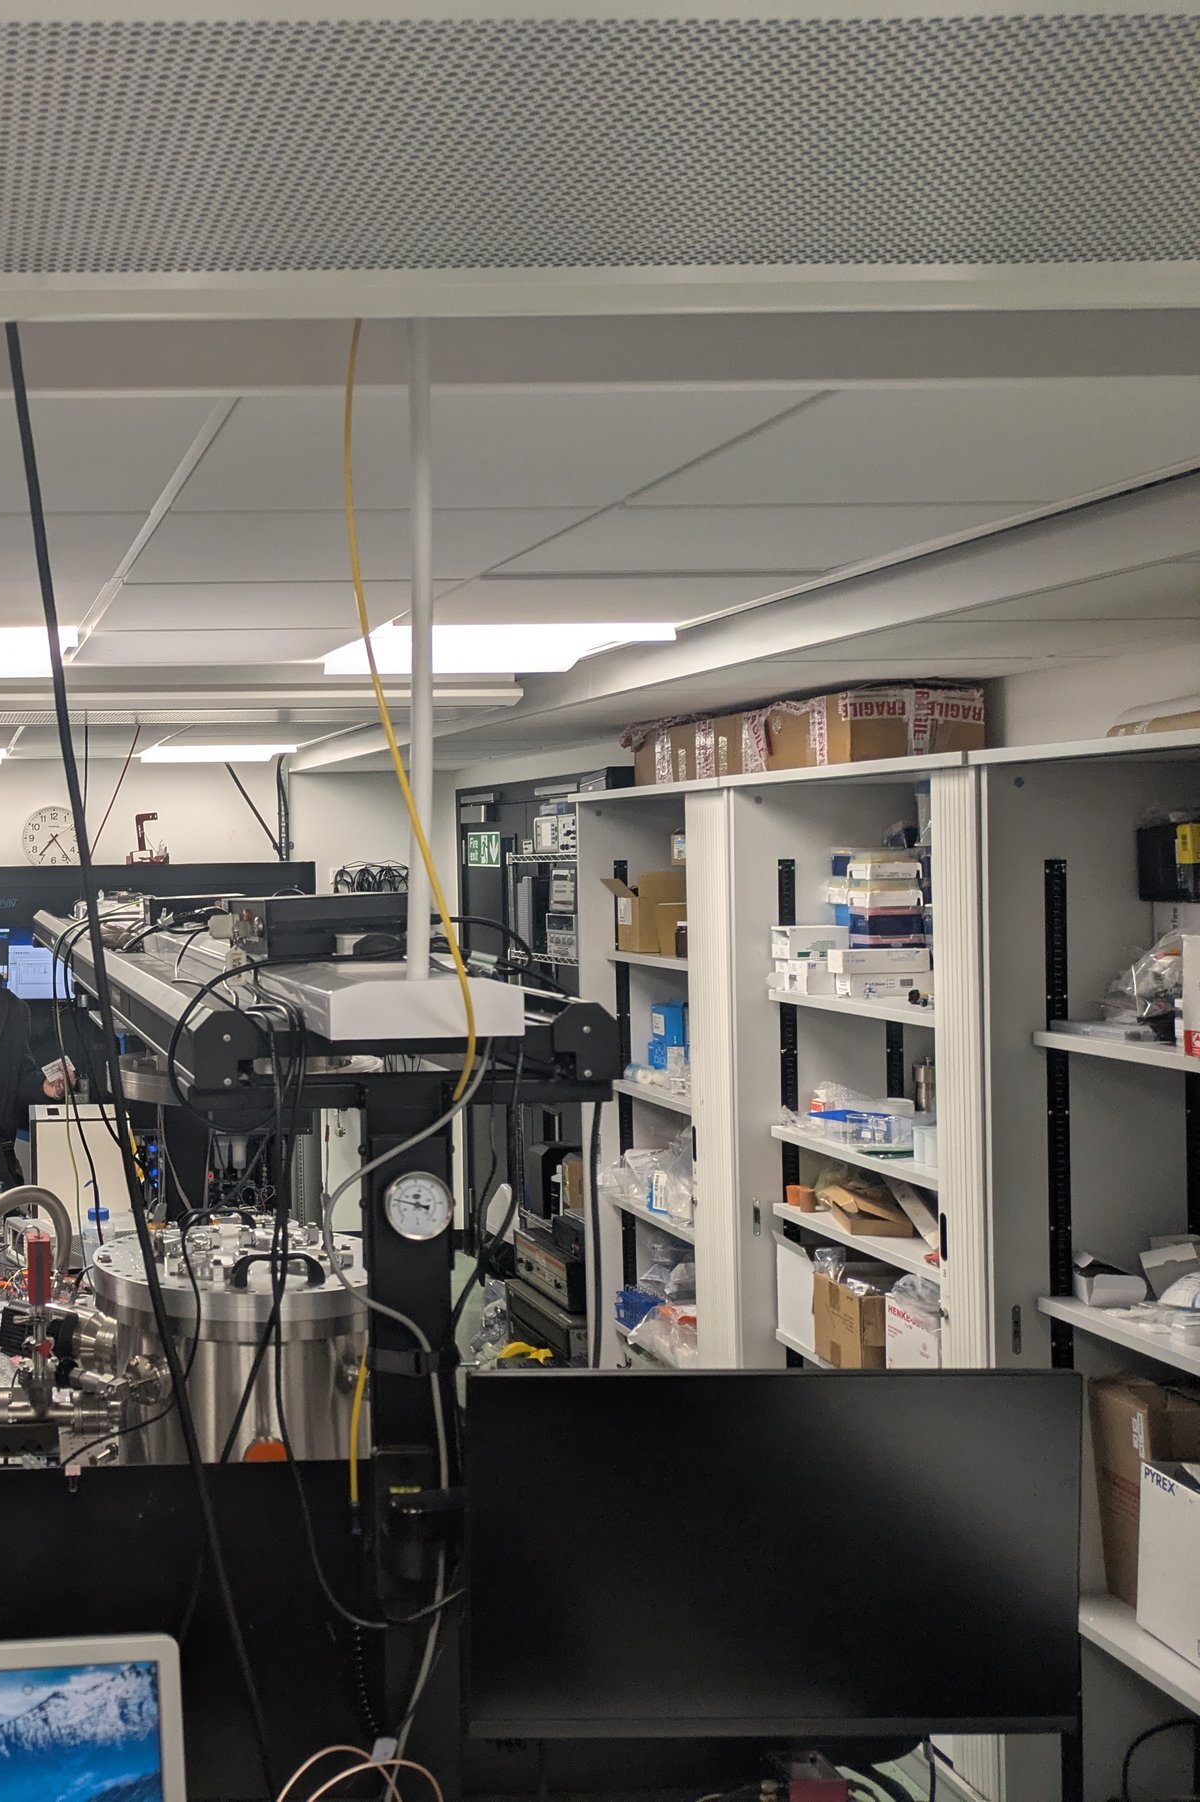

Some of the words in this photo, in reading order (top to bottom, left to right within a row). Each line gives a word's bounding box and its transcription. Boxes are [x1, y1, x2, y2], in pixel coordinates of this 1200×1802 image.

[842, 701, 906, 719] FRAGILE
[926, 701, 984, 721] RAGILE
[40, 815, 47, 823] 11
[50, 812, 59, 820] 12
[31, 823, 40, 831] 10
[469, 837, 479, 849] Fire
[470, 850, 479, 861] exit
[1144, 1467, 1176, 1497] PYREX
